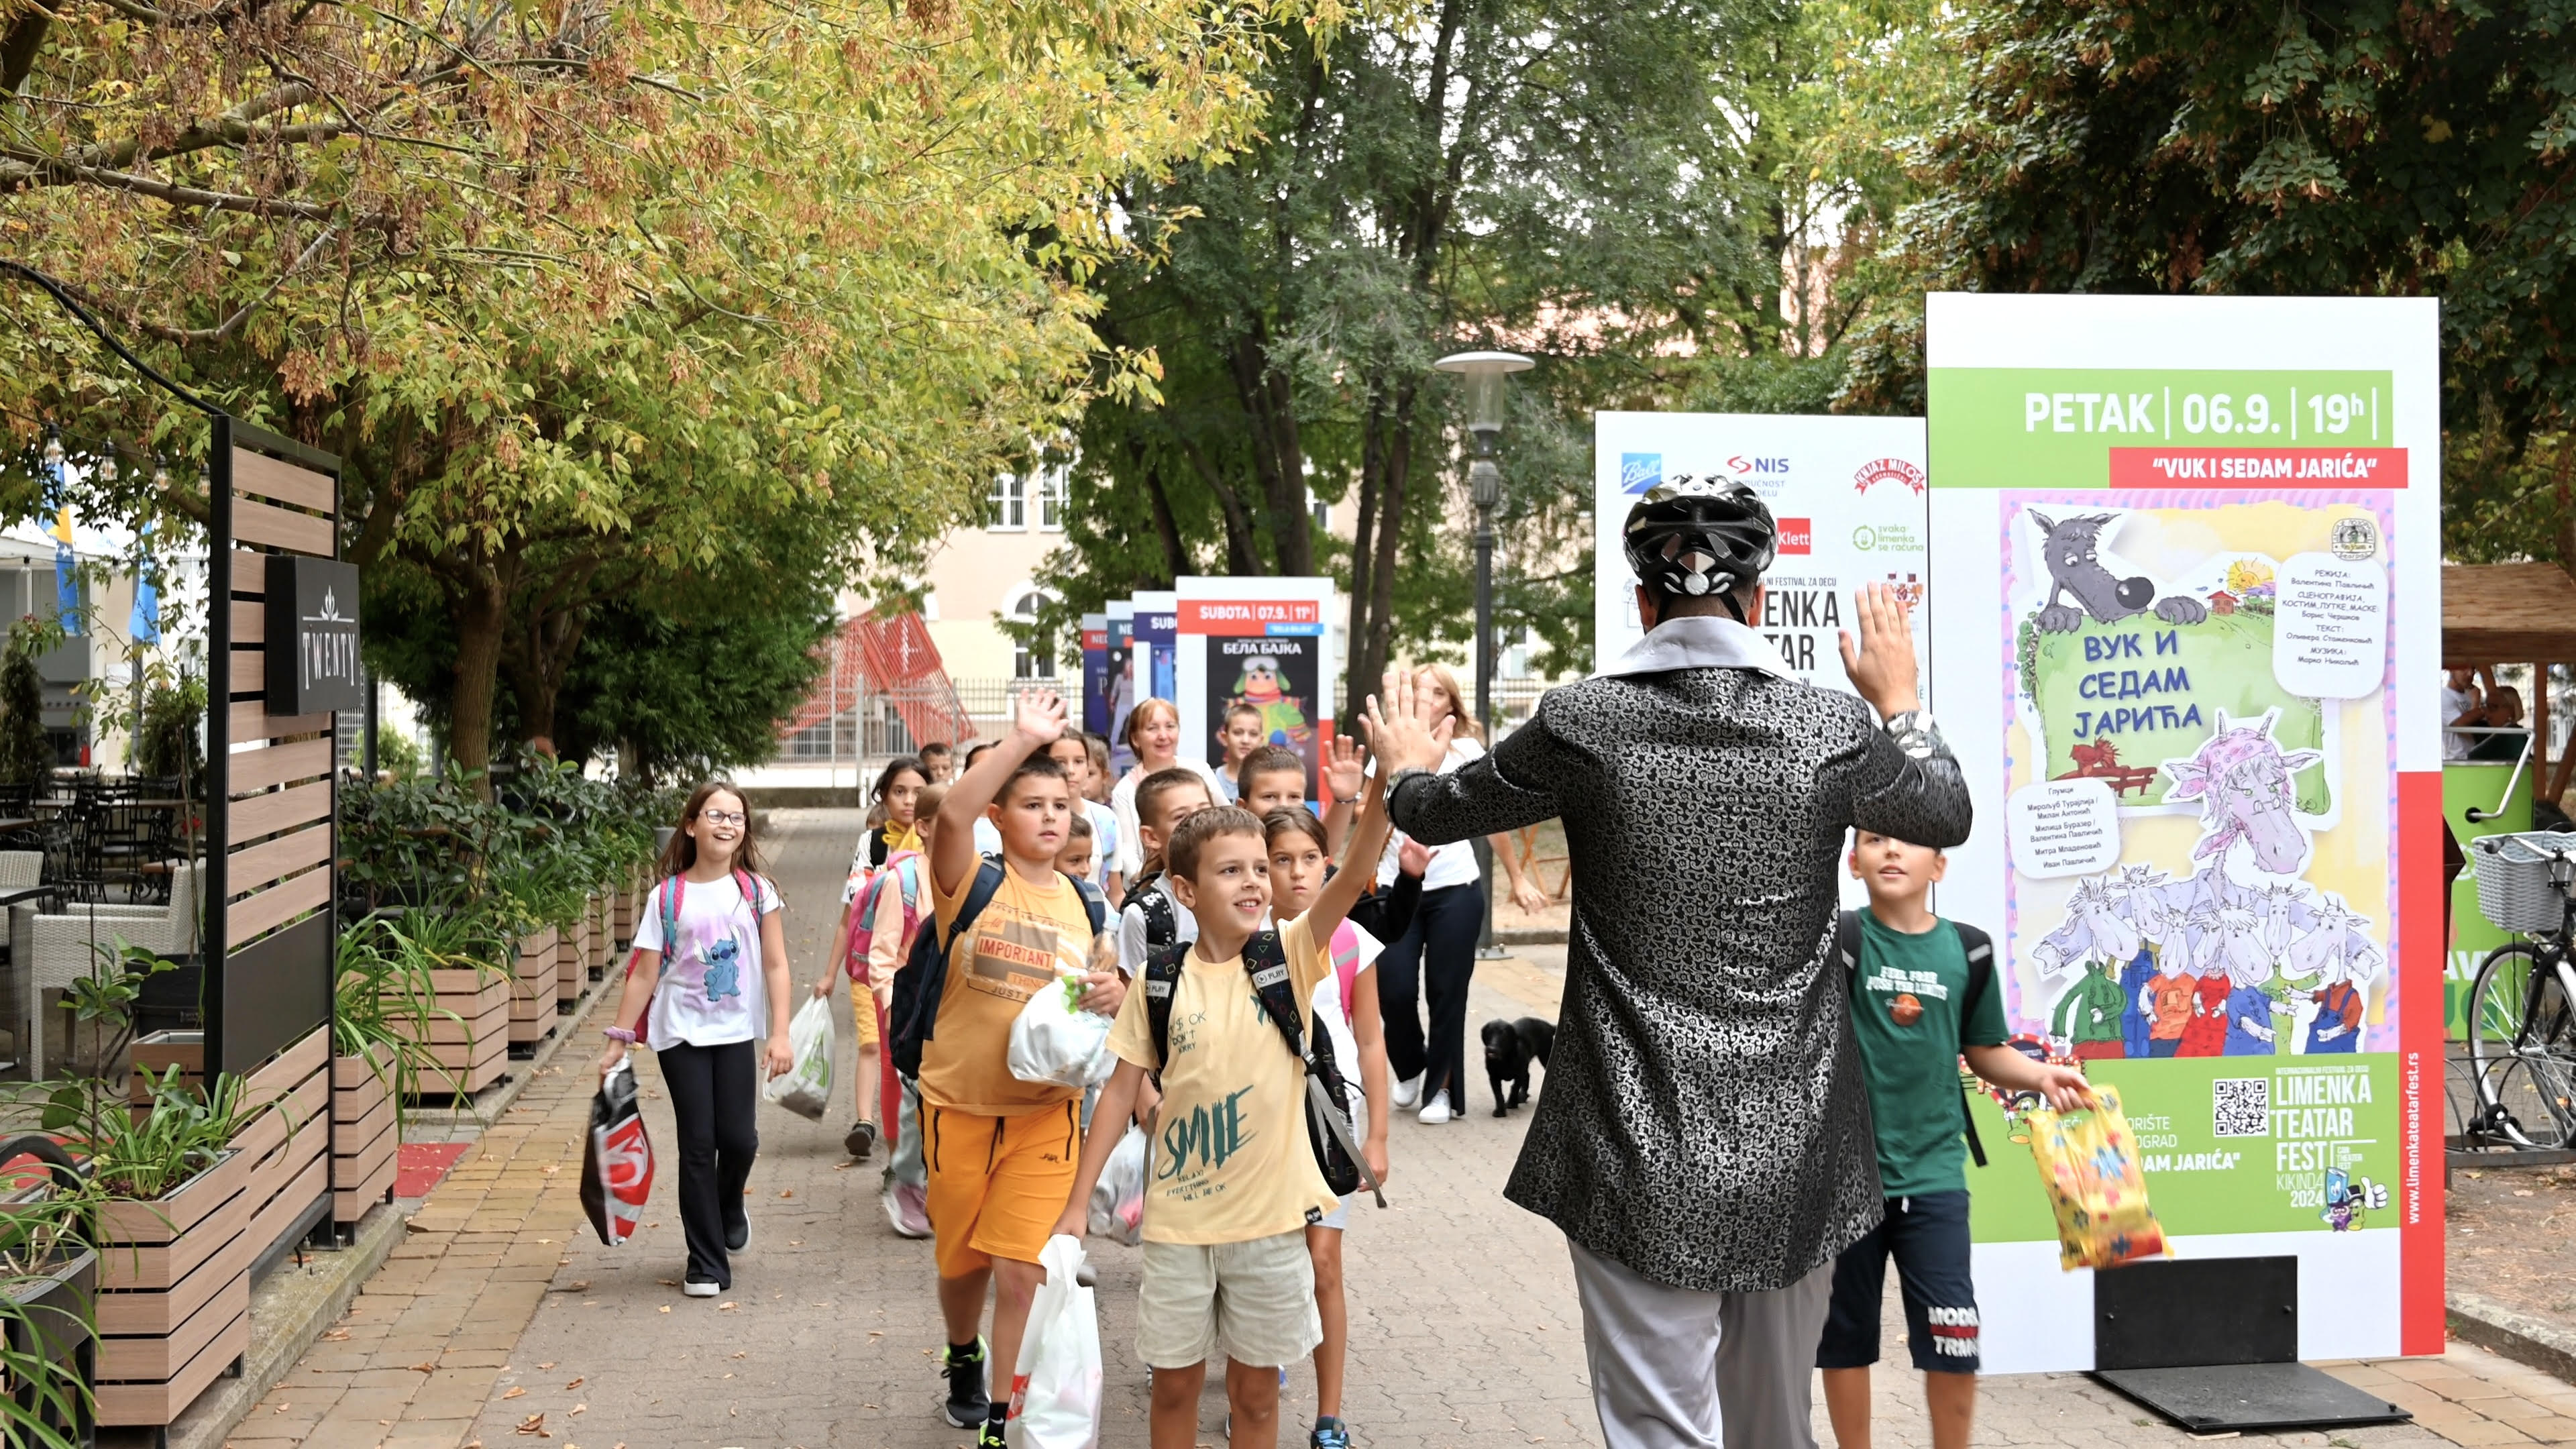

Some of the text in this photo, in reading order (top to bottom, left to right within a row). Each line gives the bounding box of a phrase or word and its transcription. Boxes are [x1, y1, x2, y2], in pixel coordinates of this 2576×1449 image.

[2025, 392, 2364, 434] PETAK 06.9. 19h
[1623, 459, 1660, 483] Ball
[1756, 458, 1789, 472] NIS
[1854, 460, 1885, 484] KNJAZ
[2210, 458, 2216, 478] I
[2220, 458, 2292, 478] SEDAM
[1878, 523, 1907, 533] svaka
[1778, 531, 1810, 545] Klett
[1878, 534, 1915, 543] limenka
[1776, 577, 1806, 586] FESTIVAL
[1808, 577, 1817, 586] ZA
[1819, 578, 1837, 586] DECU
[1199, 605, 1251, 620] SUBOTA
[1257, 606, 1287, 620] 07.9.
[2302, 610, 2324, 619] Борис
[2316, 625, 2344, 633] ТЕКСТ:
[2286, 633, 2320, 641] Оливера
[1222, 642, 1302, 655] БЕЛА БАЈКА
[2084, 629, 2178, 662] ВУК И
[303, 632, 355, 690] TWENTY
[2079, 666, 2190, 700] СЕДАМ
[2073, 703, 2202, 738] ЈАРИЋА
[2027, 801, 2061, 811] Мирољуб
[2037, 808, 2091, 820] Милан Антонић
[2035, 823, 2062, 833] Милица
[2063, 820, 2092, 830] Буразер
[2030, 833, 2067, 843] Валентина
[2035, 841, 2101, 856] Митра Младеновић
[2043, 861, 2060, 869] Иван
[979, 938, 1053, 968] IMPORTANT
[1268, 969, 1284, 979] PLAY
[991, 985, 1021, 999] JUST
[1189, 1010, 1207, 1026] OK
[2276, 1074, 2372, 1106] LIMENKA
[2269, 1108, 2353, 1138] TEATAR
[2406, 1053, 2420, 1224] www.limenkateatarfest.rs
[2173, 1148, 2241, 1171] JARIĆA"
[2276, 1141, 2327, 1171] FEST
[2276, 1173, 2324, 1191] KIKINDA
[2290, 1190, 2324, 1208] 2024
